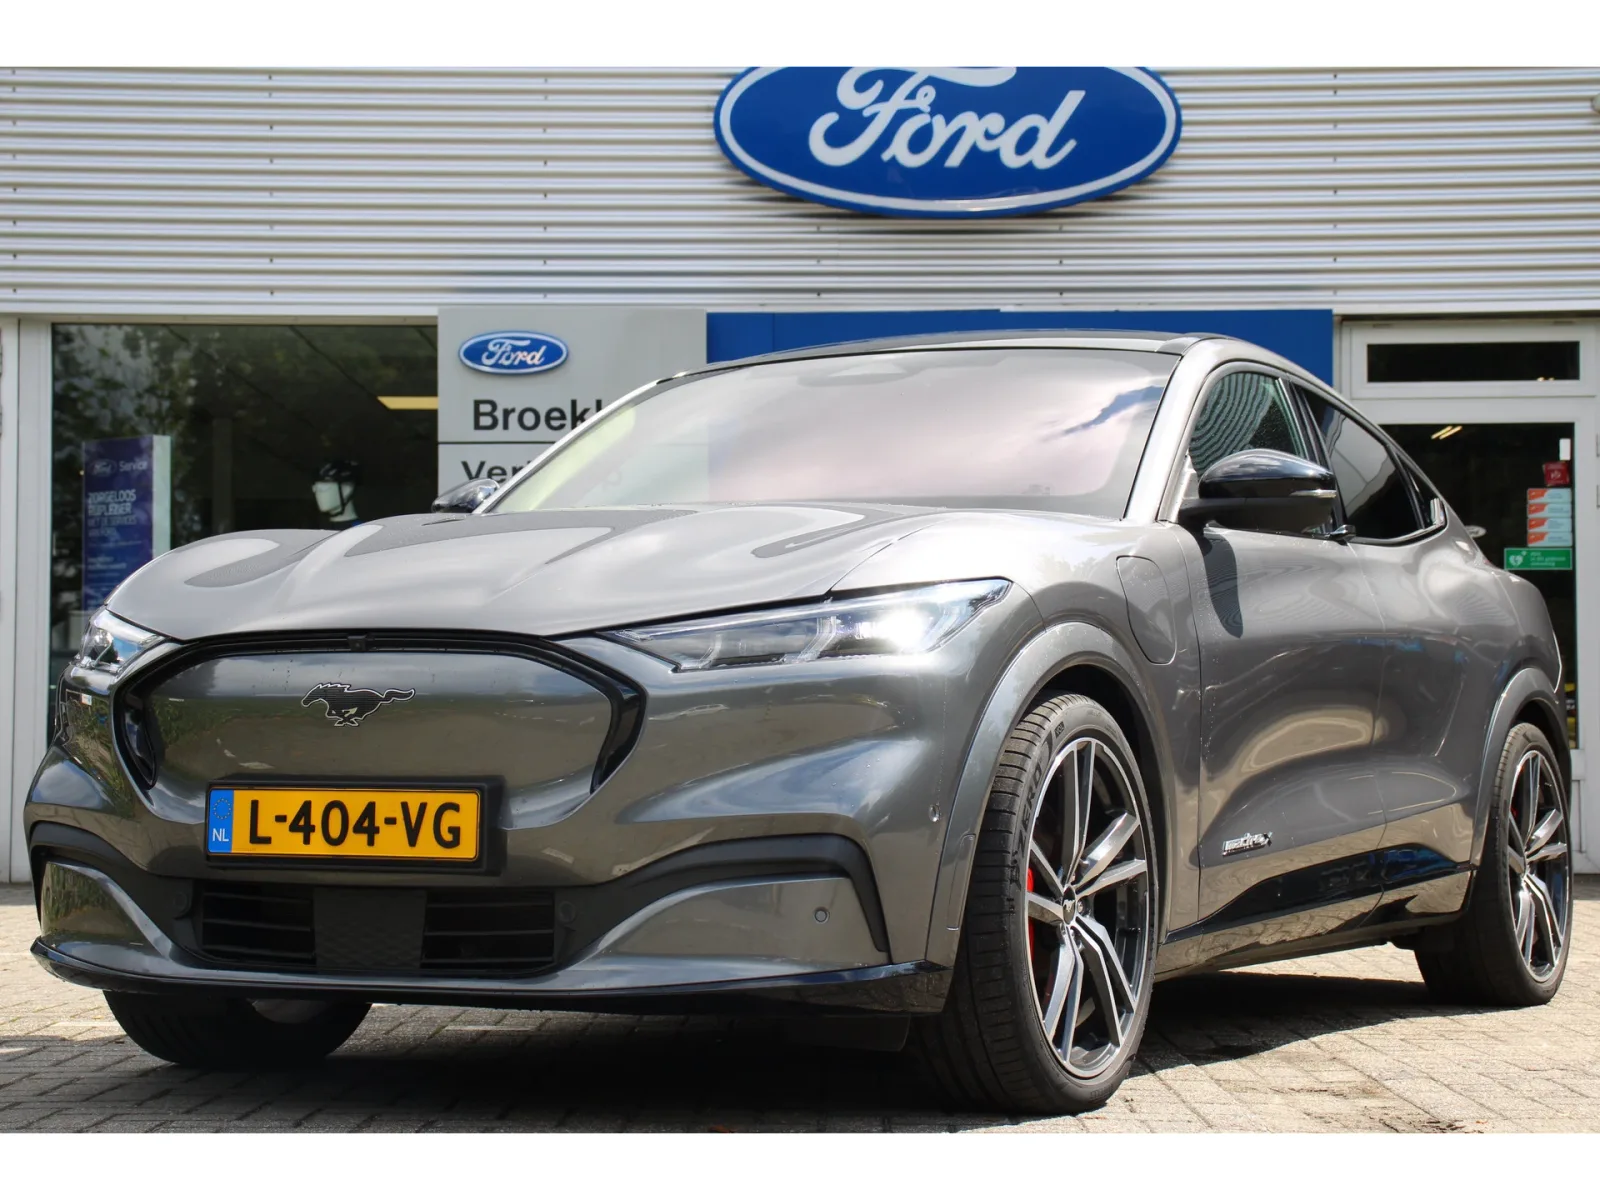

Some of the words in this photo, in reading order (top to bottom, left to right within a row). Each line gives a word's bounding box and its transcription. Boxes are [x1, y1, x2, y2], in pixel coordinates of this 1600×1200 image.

[808, 67, 1086, 170] Ford
[481, 338, 547, 366] Ford
[461, 460, 532, 484] Ver
[212, 828, 229, 842] NL
[249, 799, 461, 849] L-404-VG
